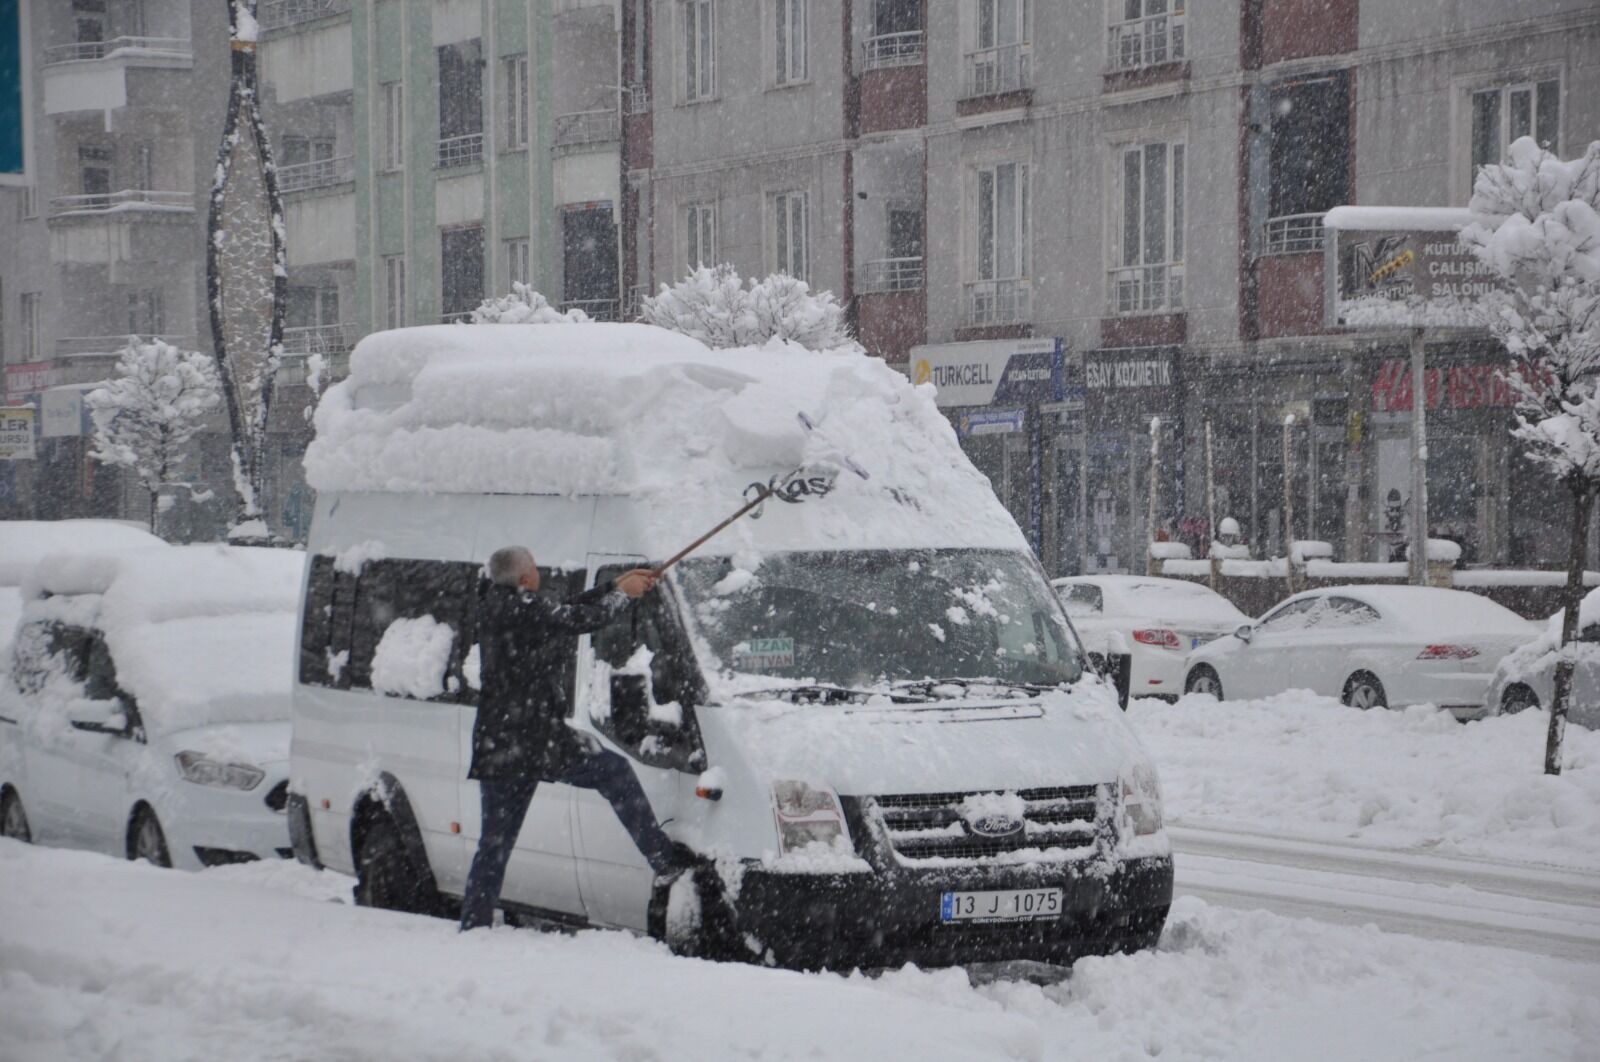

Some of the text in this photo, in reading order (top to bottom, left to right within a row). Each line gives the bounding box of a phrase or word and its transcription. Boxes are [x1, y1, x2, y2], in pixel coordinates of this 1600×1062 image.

[1350, 284, 1415, 300] OMENTUM
[1431, 282, 1496, 296] SALONU
[934, 364, 993, 386] TURKCELL
[1086, 361, 1112, 388] ESAY
[750, 639, 792, 651] IZAN
[955, 891, 1058, 916] 13 J 1075
